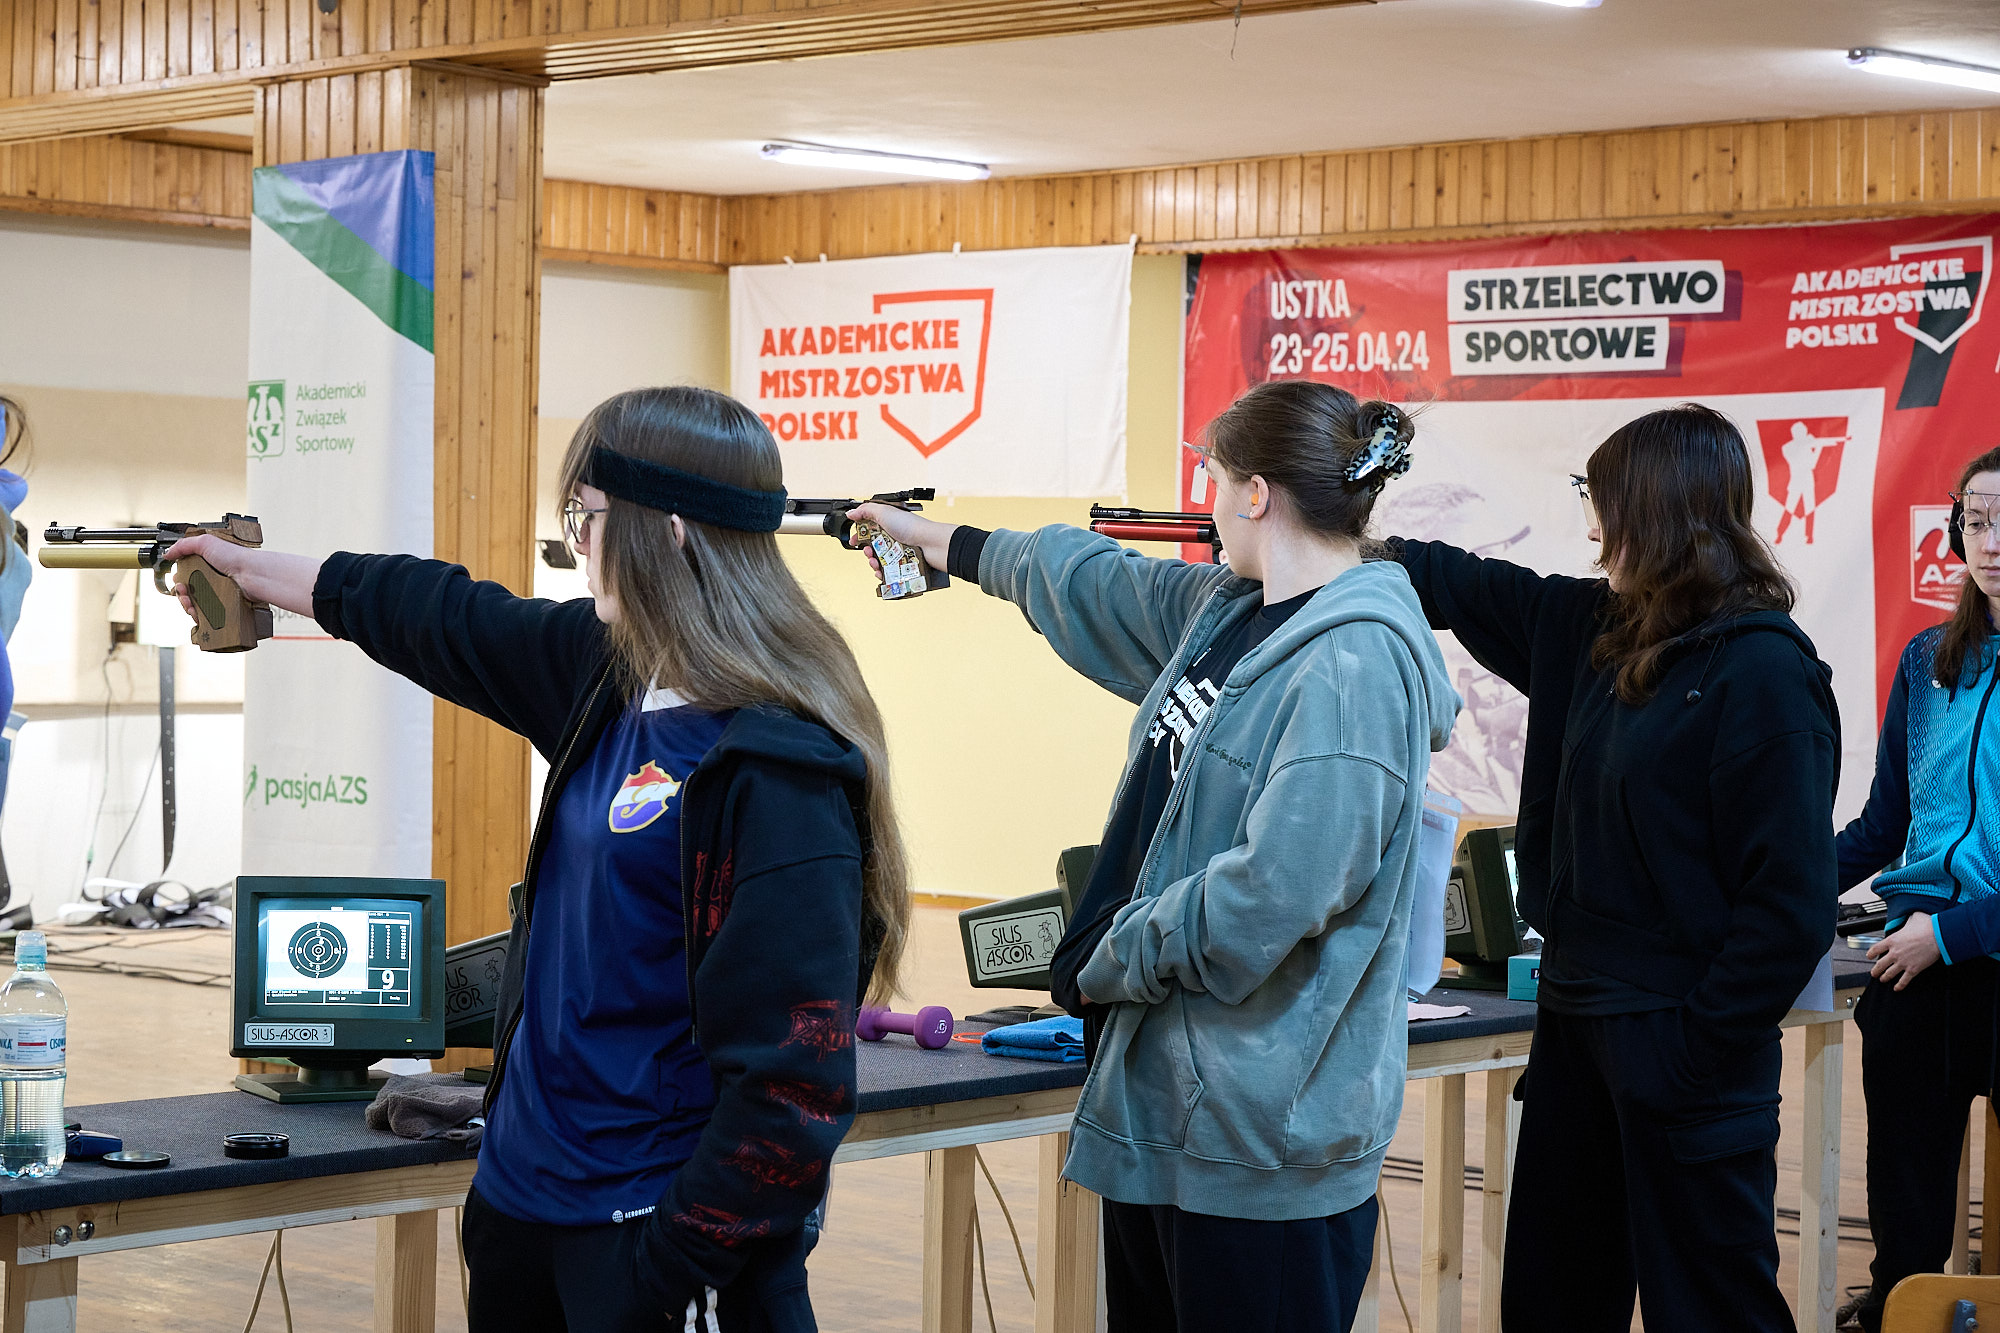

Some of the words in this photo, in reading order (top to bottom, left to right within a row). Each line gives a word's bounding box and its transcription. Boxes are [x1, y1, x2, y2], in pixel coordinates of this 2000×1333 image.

[1464, 270, 1718, 312] STRZELECTWO
[1791, 258, 1966, 295] AKADEMICKIE
[1270, 278, 1351, 320] USTKA
[1788, 286, 1972, 321] MISTRZOSTWA
[760, 319, 960, 357] AKADEMICKIE
[1270, 330, 1430, 374] 23-25.04.24
[1465, 326, 1656, 362] SPORTOWE
[1786, 322, 1879, 349] POLSKI
[296, 380, 367, 401] Akademicki
[760, 363, 965, 399] MISTRZOSTWA
[296, 408, 347, 429] Związek
[295, 435, 355, 455] Sportowy
[265, 772, 368, 809] pasjaAZS
[991, 925, 1022, 946] SIUS
[986, 944, 1035, 968] ASCOR
[381, 969, 395, 990] 9
[251, 1028, 319, 1041] SIUS-ASCOR
